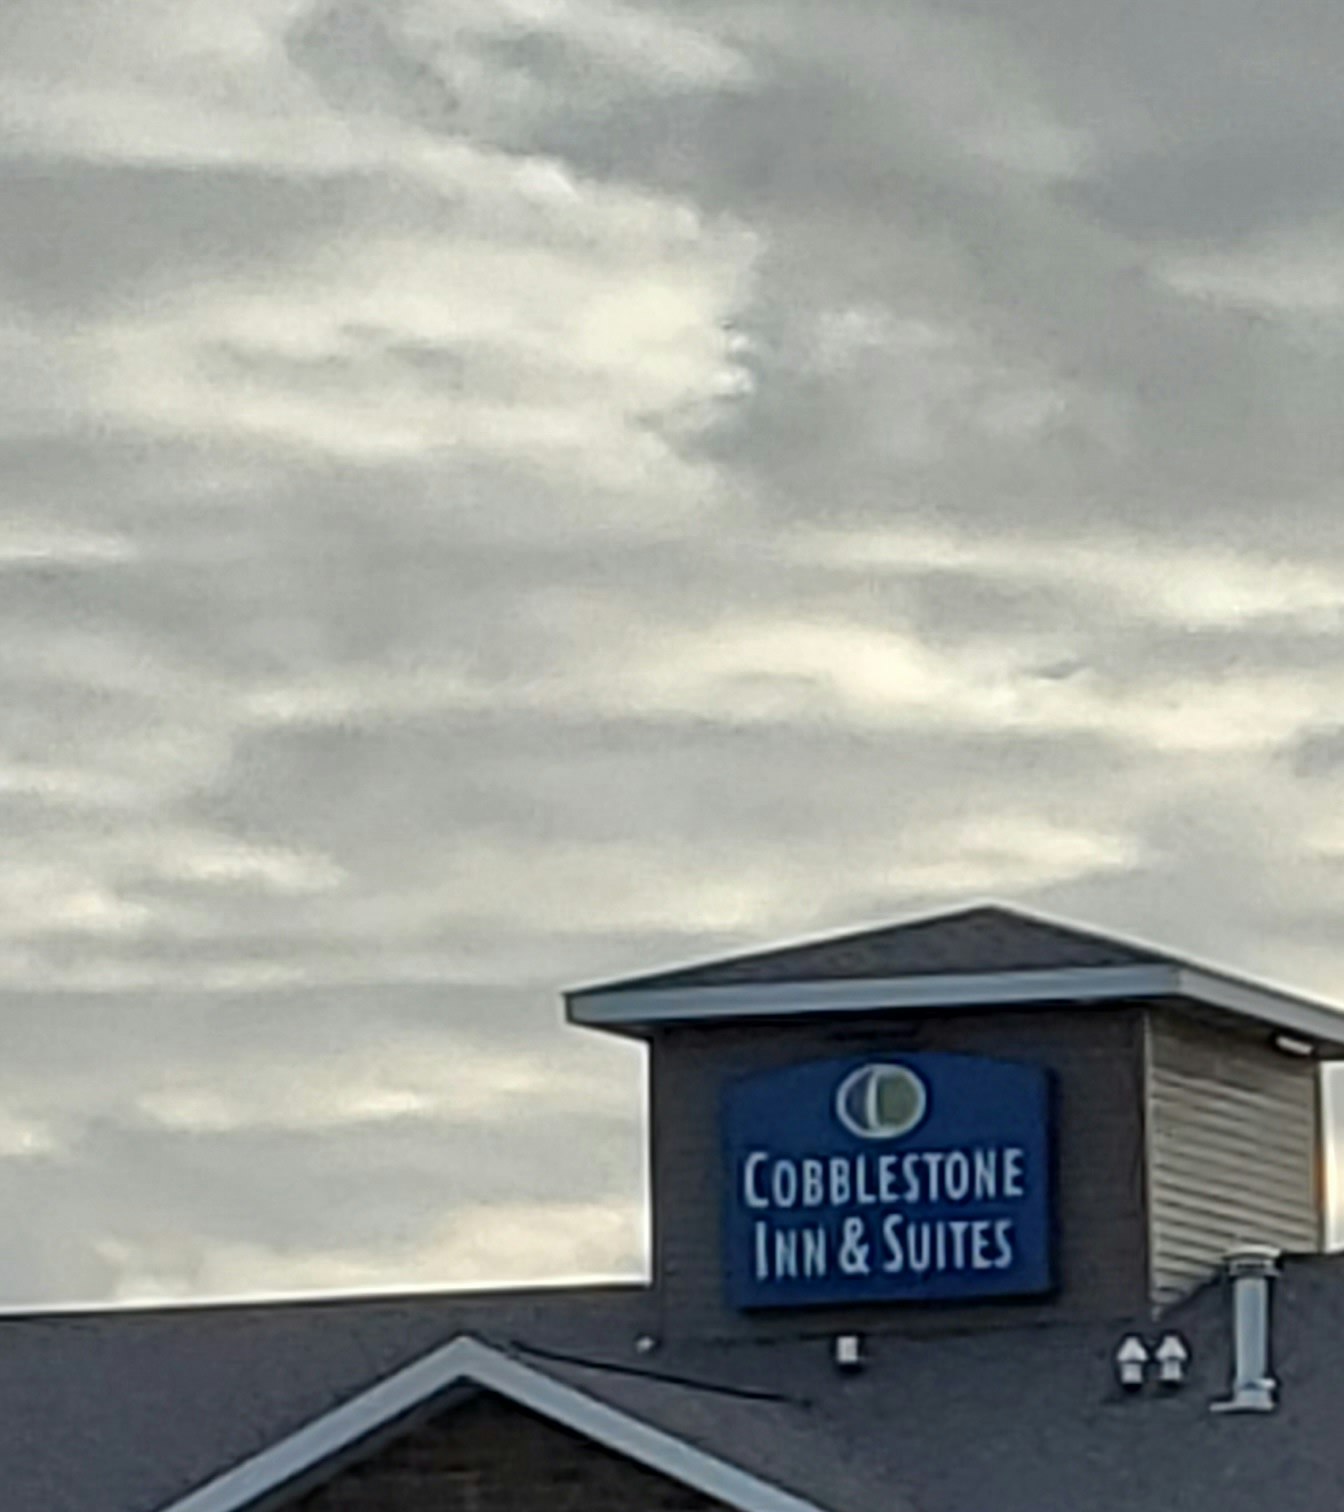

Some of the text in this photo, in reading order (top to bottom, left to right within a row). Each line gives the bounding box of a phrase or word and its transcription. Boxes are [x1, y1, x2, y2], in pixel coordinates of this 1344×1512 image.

[743, 1148, 1025, 1208] COBBLESTONE
[754, 1214, 1013, 1279] INN & SUITES
